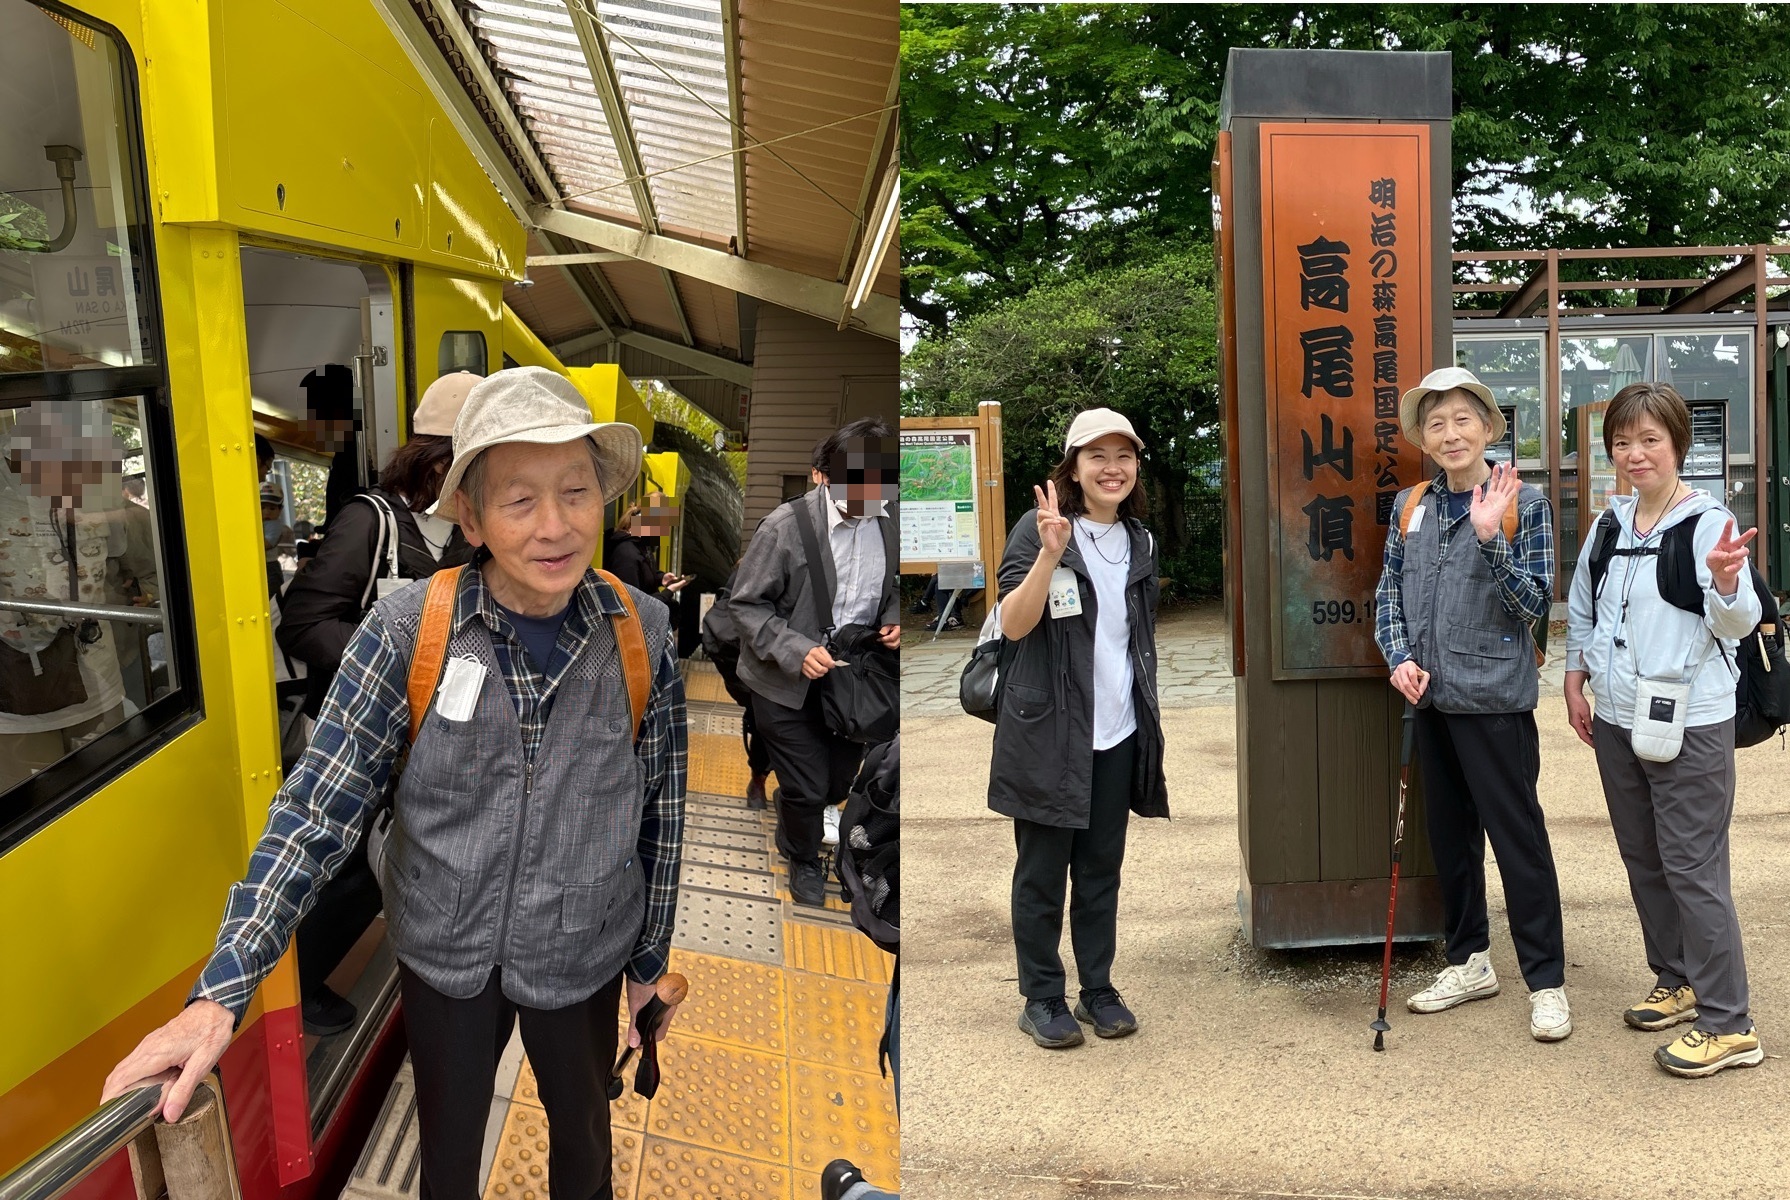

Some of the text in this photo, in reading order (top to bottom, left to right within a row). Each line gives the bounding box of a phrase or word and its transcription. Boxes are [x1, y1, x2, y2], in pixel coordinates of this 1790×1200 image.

[1297, 235, 1354, 562] 高尾山頂
[1368, 177, 1400, 525] 明治の森高尾国定公園
